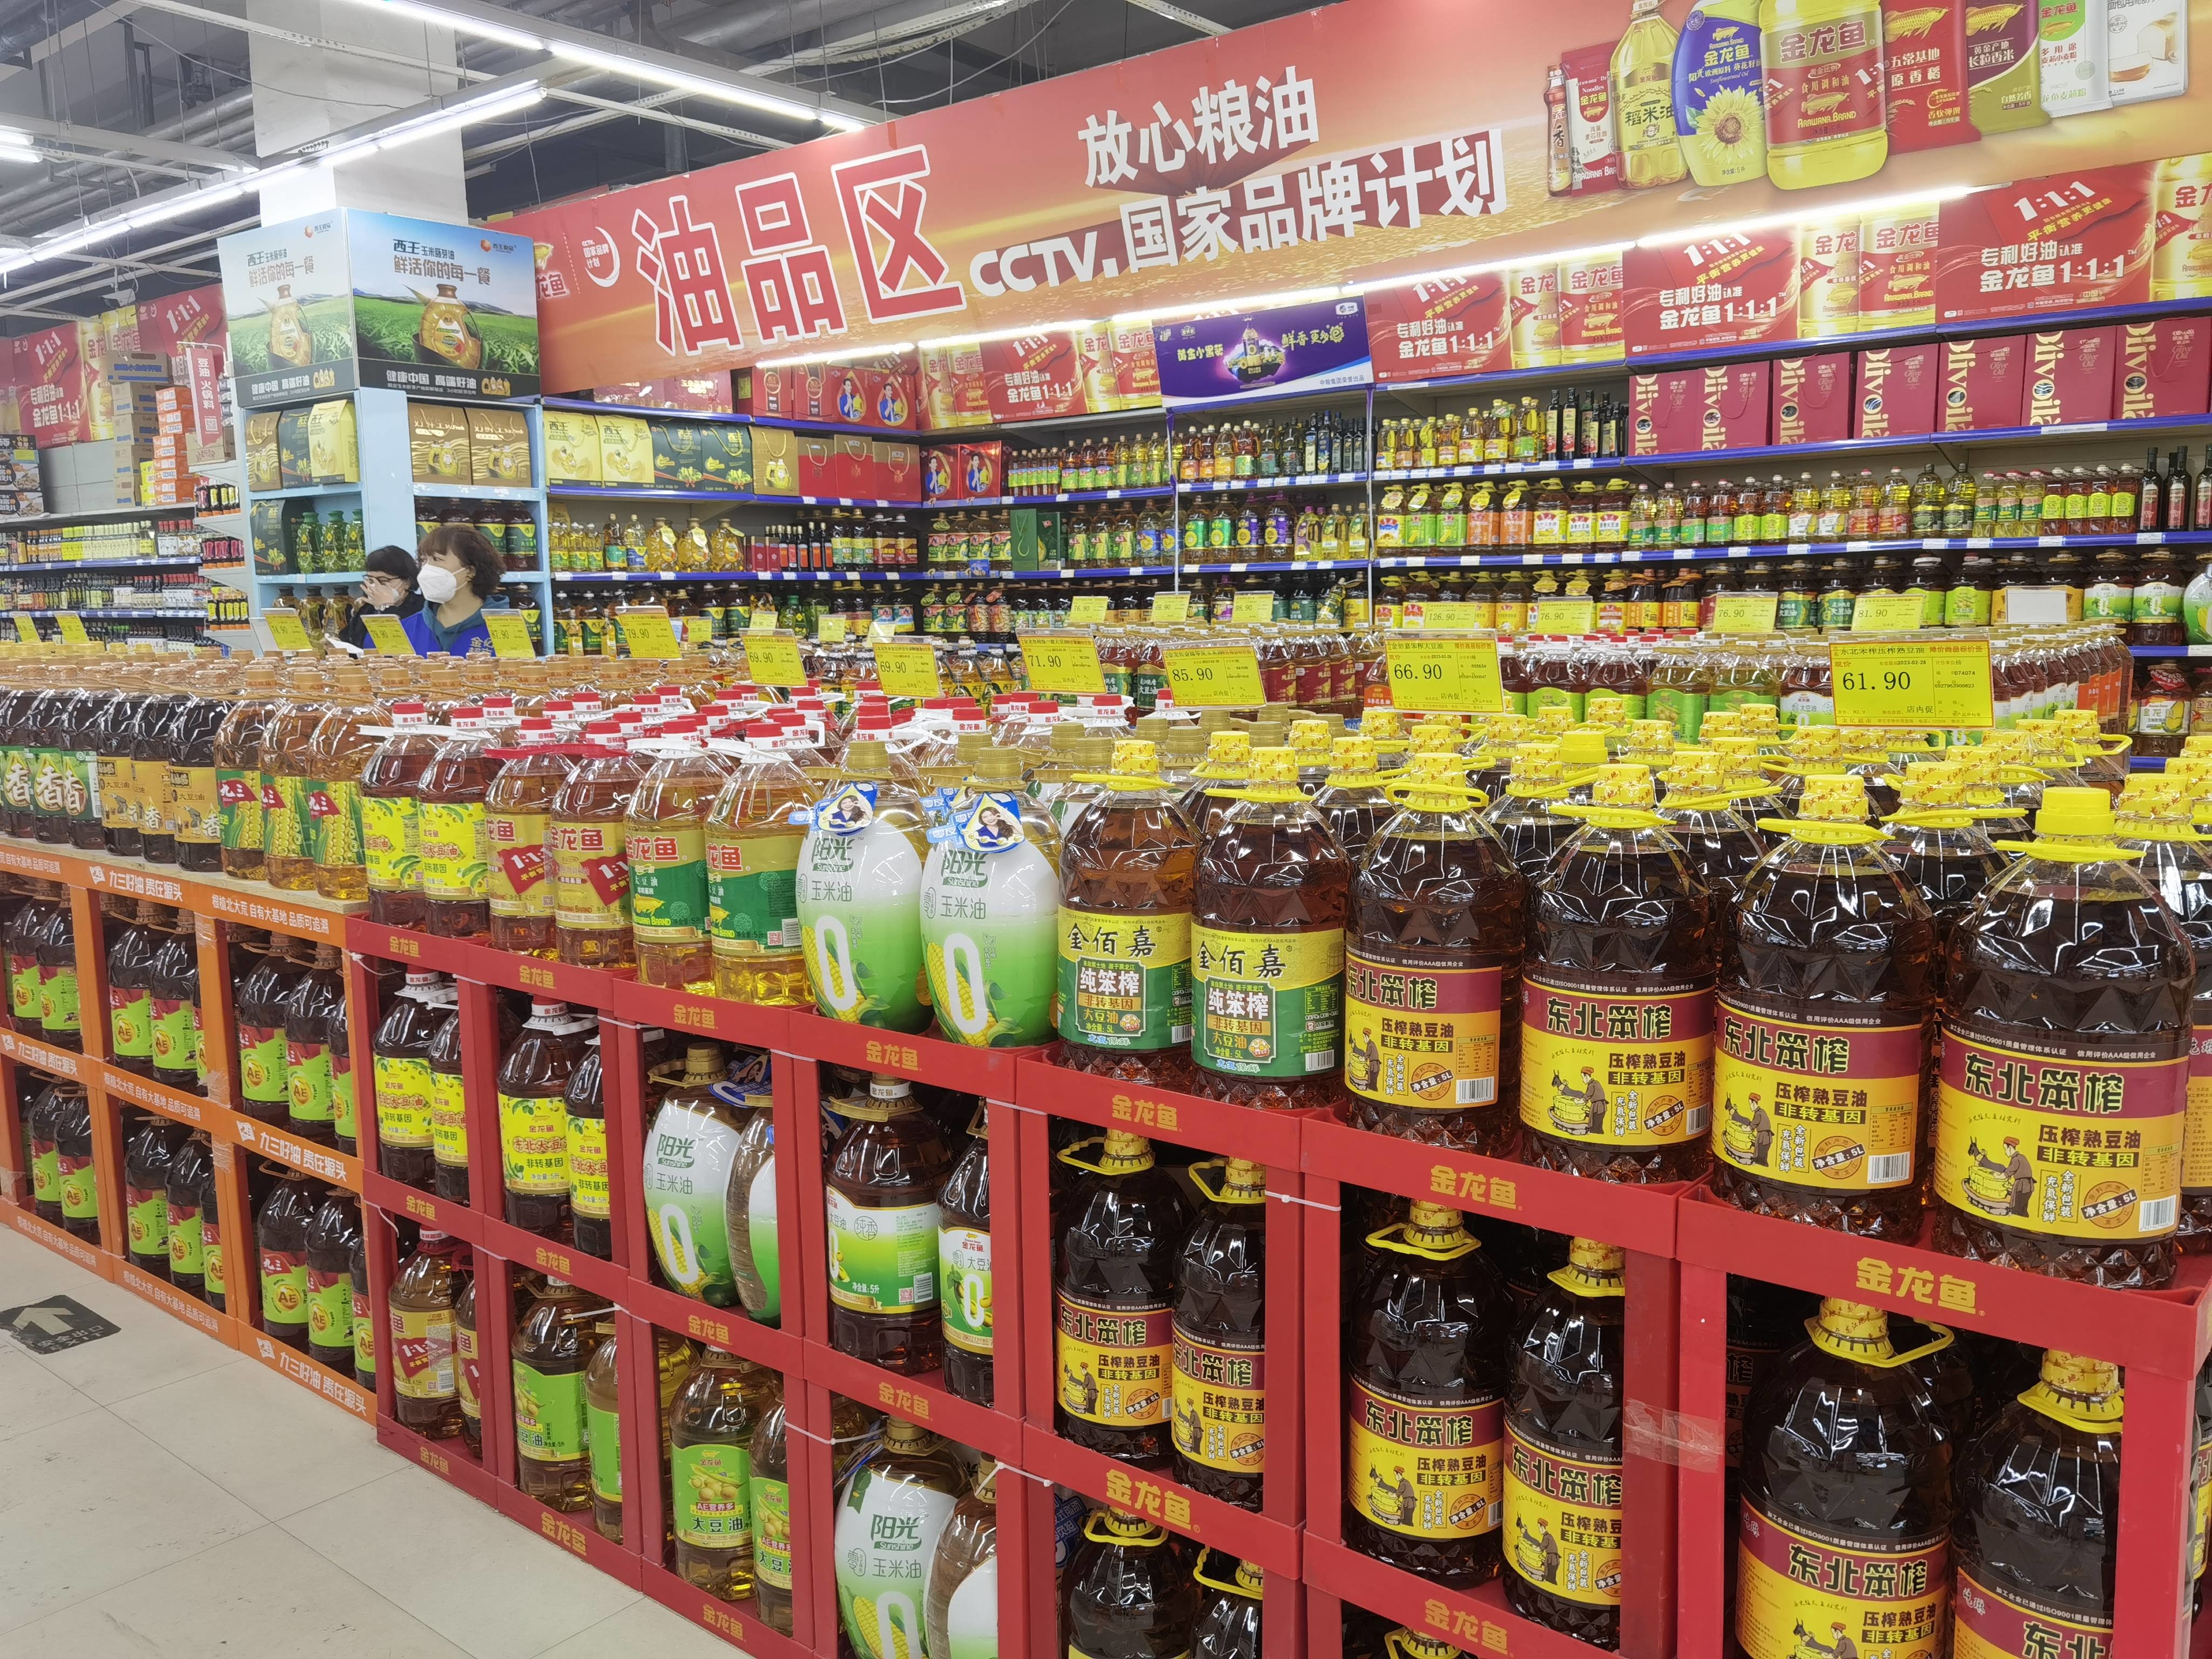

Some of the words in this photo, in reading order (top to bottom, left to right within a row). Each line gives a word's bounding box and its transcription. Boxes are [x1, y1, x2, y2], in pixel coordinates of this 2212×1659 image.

[1779, 20, 1867, 63] 金龙鱼
[1703, 45, 1750, 65] 金龙鱼
[1891, 49, 1940, 68] 五常基地
[1968, 48, 2015, 69] 长粒香米
[1077, 65, 1319, 188] 放心粮油
[2014, 181, 2095, 221] 1:1:1
[2027, 198, 2112, 241] 平衡营养更健康
[247, 252, 266, 267] 西王
[393, 238, 420, 255] 西王
[421, 246, 455, 260] 玉米胚芽油
[583, 244, 609, 258] 国家品牌
[631, 144, 967, 356] 油品区
[1683, 231, 1751, 267] 1:1:1
[248, 256, 314, 288] 鲜活你的每一餐
[393, 255, 491, 286] 鲜活你的每一餐
[586, 258, 600, 268] 计划
[1696, 245, 1765, 285] 平衡营养更健康
[1425, 285, 1479, 320] 平衡营养更健康
[252, 379, 279, 395] 健康中国
[281, 375, 310, 391] 高端好油
[386, 369, 429, 386] 健康中国
[435, 373, 476, 389] 高端好油
[1428, 612, 1456, 622] 126.90
[1540, 611, 1565, 622] 76.90
[1718, 608, 1745, 618] 76.90
[1858, 608, 1888, 619] 81.90
[625, 628, 651, 640] 79.90
[749, 651, 773, 664] 69.90
[880, 660, 907, 674] 69.90
[1028, 655, 1062, 668] 71.90
[1172, 667, 1213, 682] 85.90
[1394, 664, 1442, 679] 66.90
[1843, 671, 1911, 690] 61.90
[1906, 705, 1934, 713] 店内促
[35, 766, 64, 811] 香
[812, 836, 853, 864] 阳光
[109, 871, 144, 894] 九三好油
[146, 879, 184, 902] 贵在源头
[811, 881, 852, 902] 玉米油
[212, 894, 248, 916] 根植北大荒
[249, 902, 287, 926] 自有大基地
[288, 912, 329, 934] 品质可追溯
[940, 895, 986, 920] 玉米油
[1067, 922, 1157, 957] 金佰嘉
[1197, 940, 1287, 979] 金佰嘉
[519, 965, 555, 989] 金龙鱼
[1080, 967, 1139, 997] 纯笨榨
[1347, 962, 1438, 1009] 东北笨榨
[1085, 996, 1133, 1011] 非转基因
[1208, 987, 1269, 1020] 纯笨榨
[1083, 1010, 1119, 1025] 大豆油
[1213, 1016, 1262, 1034] 非转基因
[1381, 1017, 1454, 1038] 压榨熟豆油
[1547, 997, 1672, 1040] 东北笨榨
[1212, 1030, 1247, 1049] 大豆油
[1384, 1036, 1449, 1053] 非转基因
[1724, 1016, 1850, 1074] 东北笨榨
[18, 1041, 46, 1067] 九三好油
[48, 1051, 78, 1076] 贵在源头
[866, 1040, 920, 1071] 金龙鱼
[1608, 1050, 1685, 1070] 压榨熟豆油
[1611, 1071, 1681, 1085] 非转基因
[1964, 1053, 2124, 1114] 东北笨榨
[104, 1073, 134, 1095] 根植北大荒
[136, 1083, 166, 1109] 自有大基地
[167, 1092, 201, 1121] 品质可追溯
[1775, 1082, 1867, 1108] 压榨熟豆油
[1112, 1094, 1178, 1132] 金龙鱼
[1779, 1103, 1862, 1122] 非转基因
[657, 1134, 695, 1157] 阳光
[1793, 1124, 1806, 1168] 全新包装
[2038, 1124, 2141, 1150] 压榨熟豆油
[259, 1131, 301, 1162] 九三好油
[303, 1148, 347, 1183] 贵在源头
[526, 1157, 564, 1169] 非转基因
[2041, 1148, 2135, 1168] 非转基因
[656, 1172, 693, 1195] 玉米油
[1430, 1165, 1517, 1210] 金龙鱼
[2060, 1170, 2075, 1218] 全新包装
[852, 1282, 880, 1294] 净含量:5升
[1856, 1257, 1977, 1314] 金龙鱼
[1060, 1304, 1147, 1346] 东北笨榨
[1098, 1354, 1160, 1368] 压榨熟豆油
[279, 1351, 321, 1388] 九三好油
[322, 1377, 367, 1416] 贵在源头
[1102, 1368, 1157, 1380] 非转基因
[879, 1381, 931, 1420] 金龙鱼
[1365, 1400, 1473, 1447] 东北笨榨
[1417, 1454, 1486, 1472] 压榨熟豆油
[1512, 1444, 1622, 1506] 东北笨榨
[1420, 1473, 1483, 1486] 非转基因
[1106, 1469, 1191, 1530] 金龙鱼
[692, 1516, 744, 1534] 大豆油
[871, 1514, 921, 1541] 阳光
[880, 1541, 914, 1552] Sunshine
[872, 1557, 922, 1579] 玉米油
[1788, 1543, 1928, 1599] 东北笨榨
[703, 1604, 745, 1642] 金龙鱼
[1424, 1598, 1508, 1655] 金龙鱼
[1863, 1602, 1936, 1628] 压榨熟豆油
